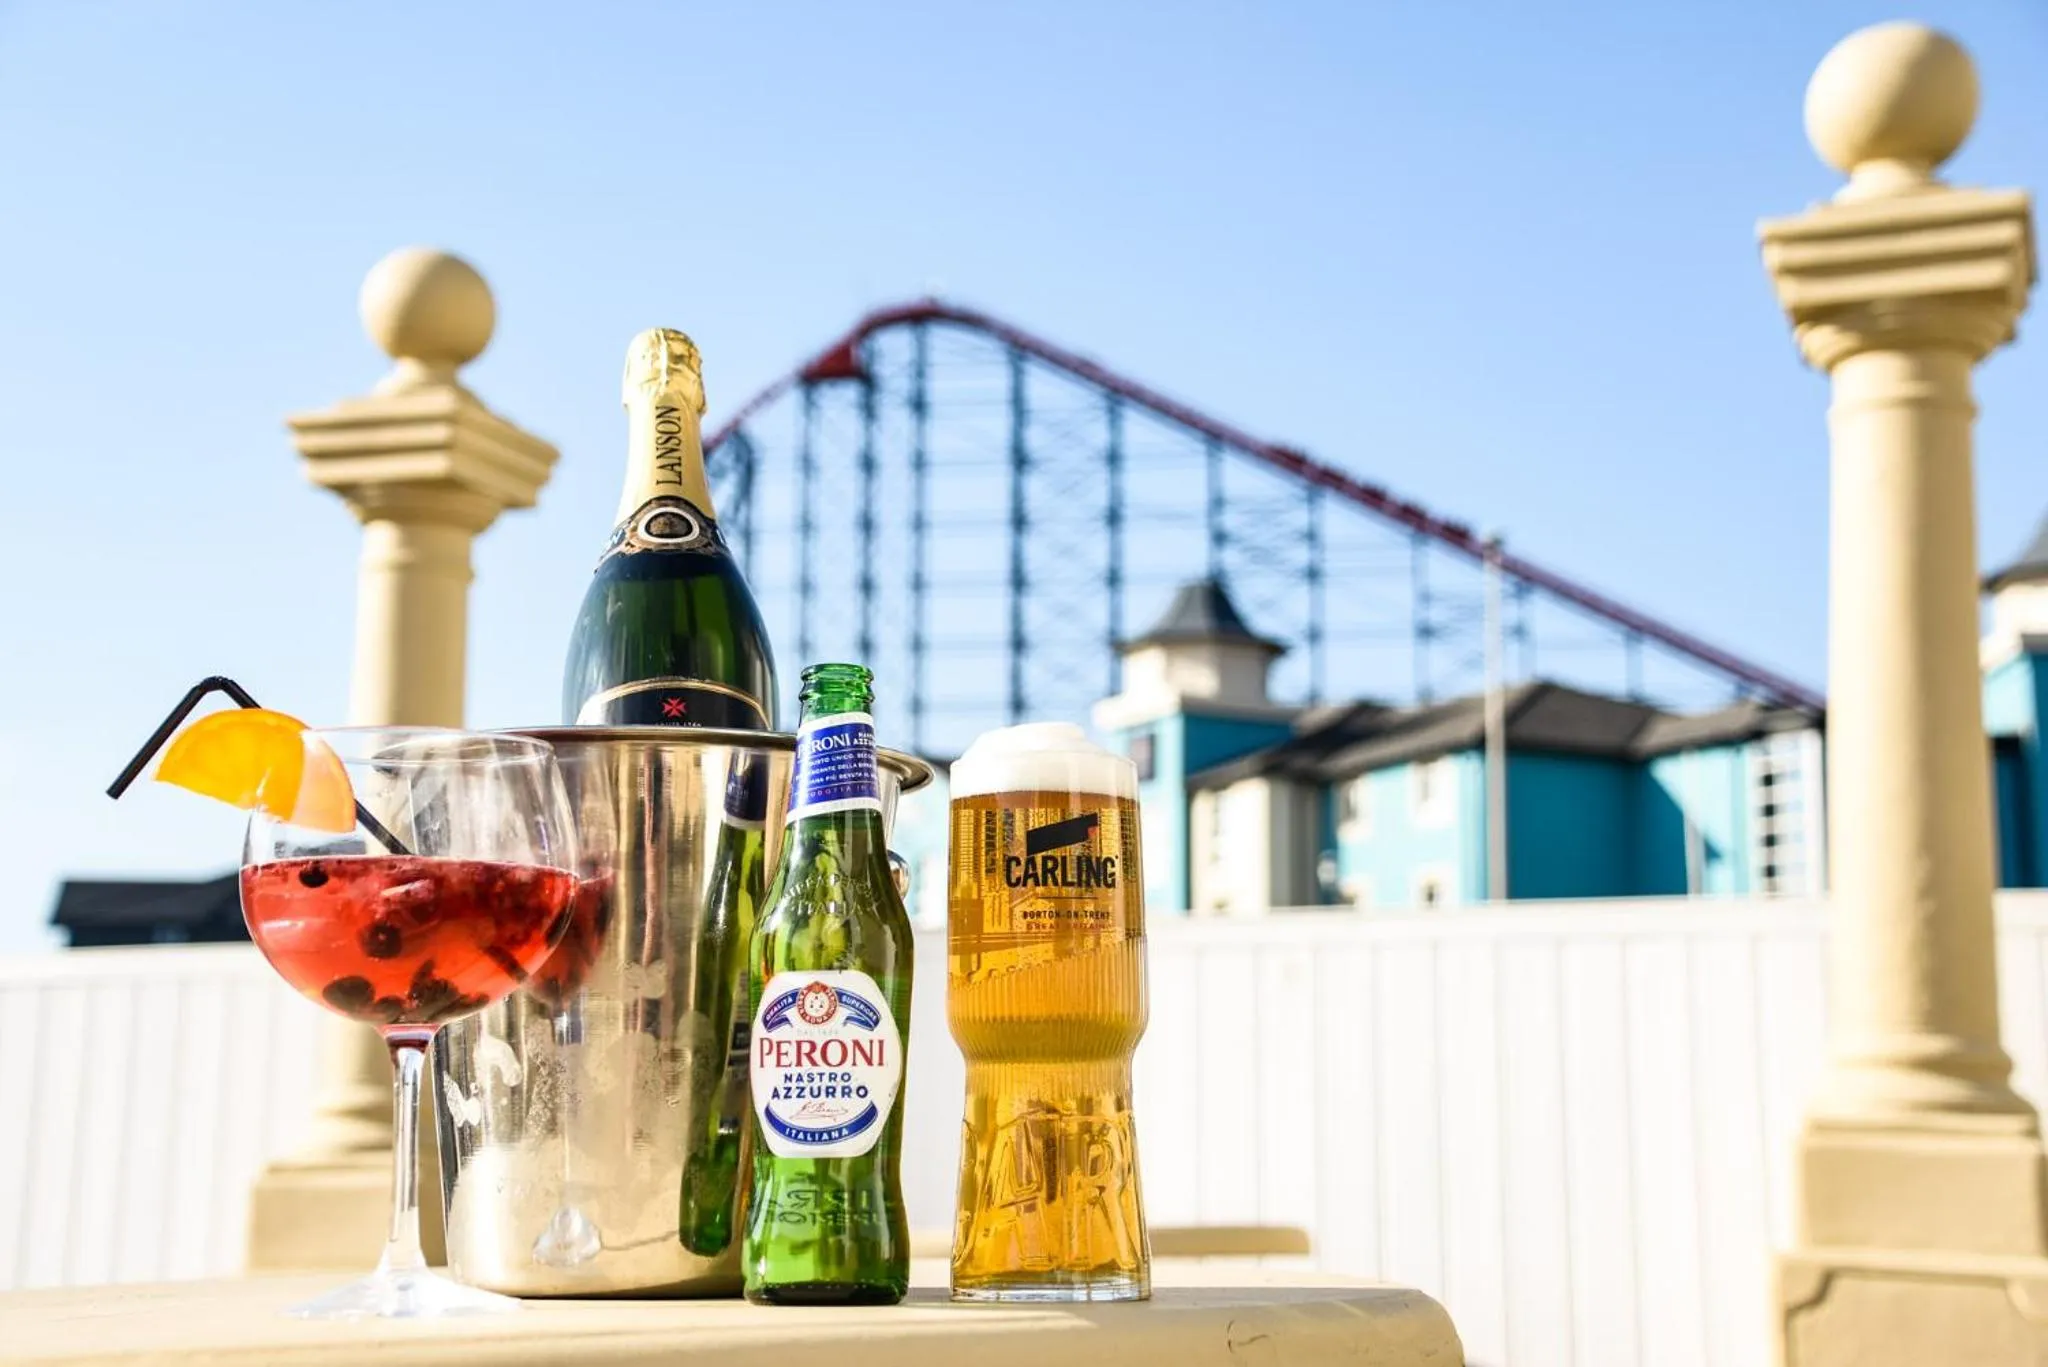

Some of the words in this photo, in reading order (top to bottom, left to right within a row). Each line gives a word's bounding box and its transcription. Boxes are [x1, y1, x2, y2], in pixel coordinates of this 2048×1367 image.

[655, 405, 683, 488] LANSON
[1005, 855, 1117, 889] CARLING
[758, 1037, 885, 1069] PERONI
[784, 1071, 852, 1083] NASTRO
[771, 1085, 869, 1100] AZZURRO
[784, 1127, 849, 1141] ITALIANA
